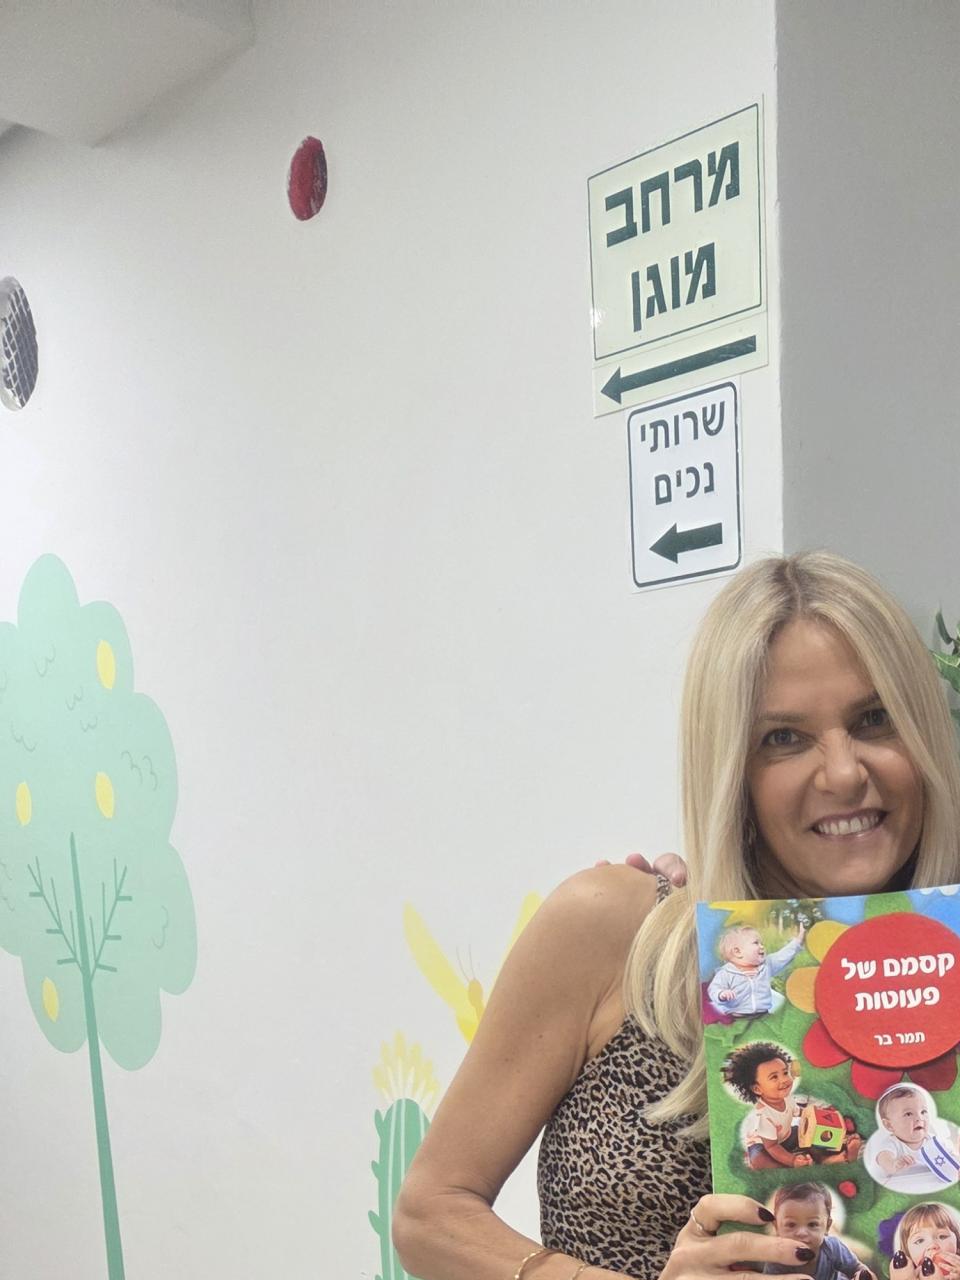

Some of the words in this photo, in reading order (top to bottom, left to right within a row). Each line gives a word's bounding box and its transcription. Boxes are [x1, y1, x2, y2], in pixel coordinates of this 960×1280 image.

[605, 141, 740, 248] מרחב
[631, 242, 716, 332] מוגן
[640, 401, 726, 453] שרותי
[655, 461, 715, 506] נכים
[840, 957, 876, 980] של
[883, 952, 955, 978] קסמם
[855, 986, 940, 1011] פעוטות
[874, 1033, 893, 1046] בר
[895, 1031, 925, 1044] תמר
